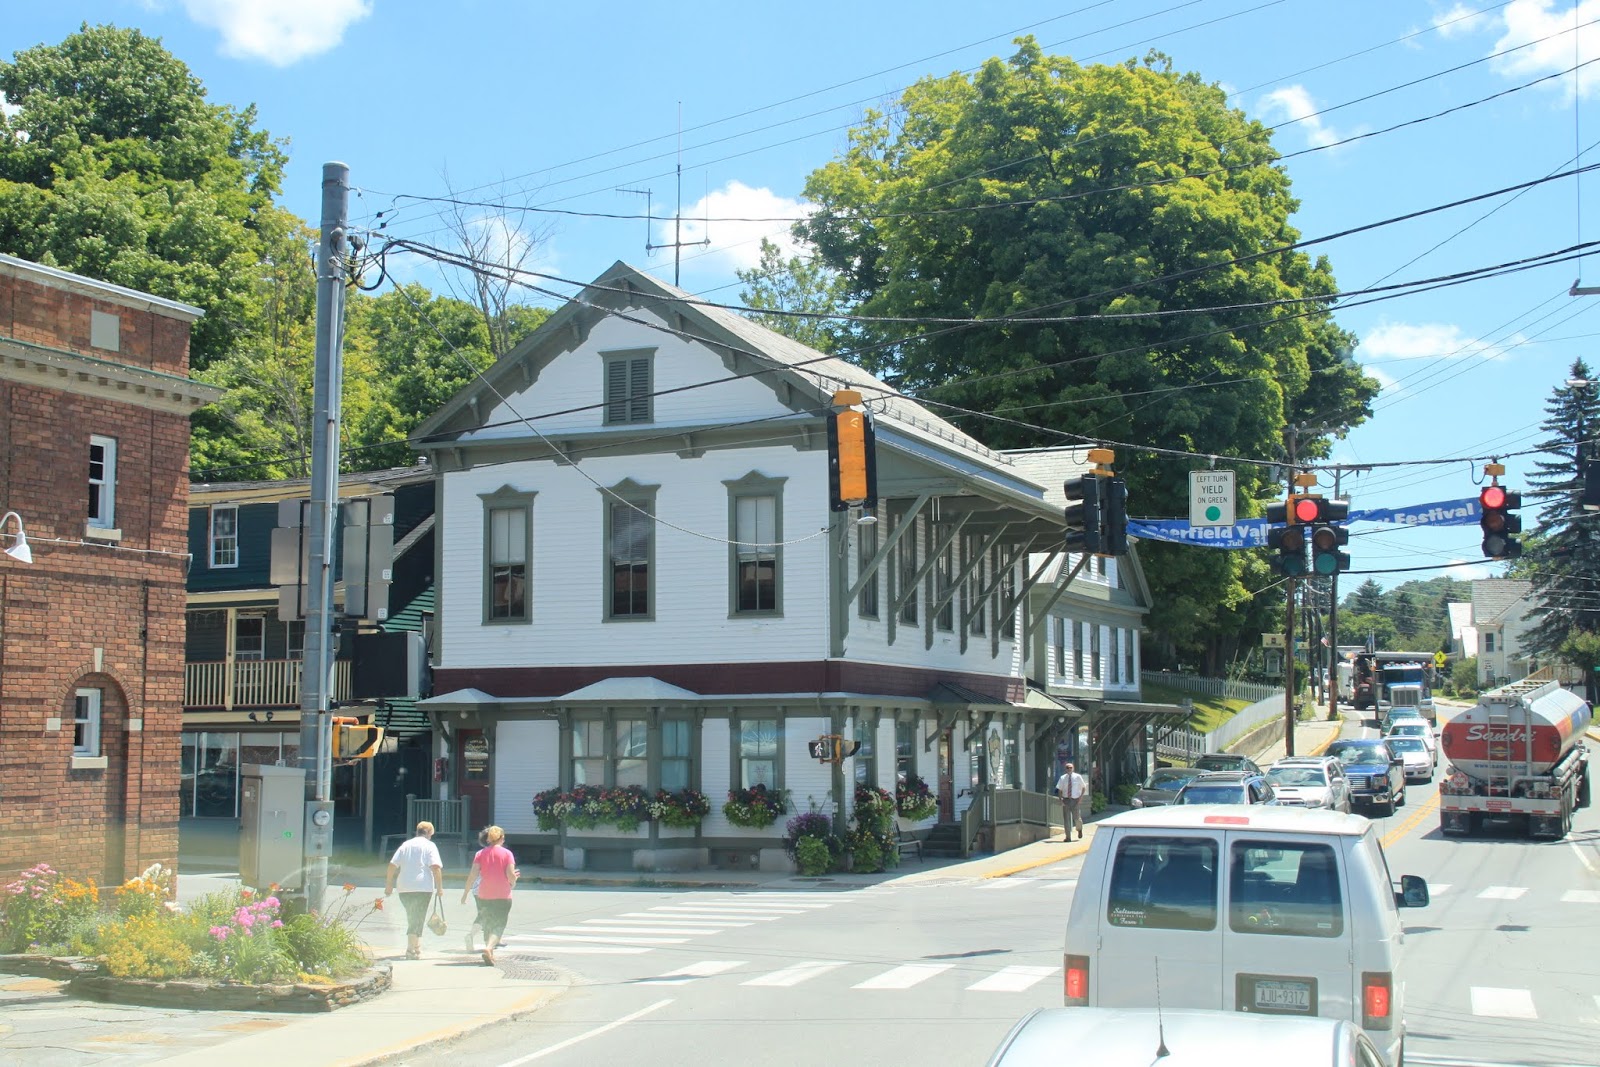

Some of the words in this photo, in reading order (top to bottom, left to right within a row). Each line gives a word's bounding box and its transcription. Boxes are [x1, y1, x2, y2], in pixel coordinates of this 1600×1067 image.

[1196, 475, 1210, 483] LEFT
[1212, 474, 1228, 482] TURN
[1201, 485, 1224, 494] YIELD
[1394, 502, 1475, 525] Festival
